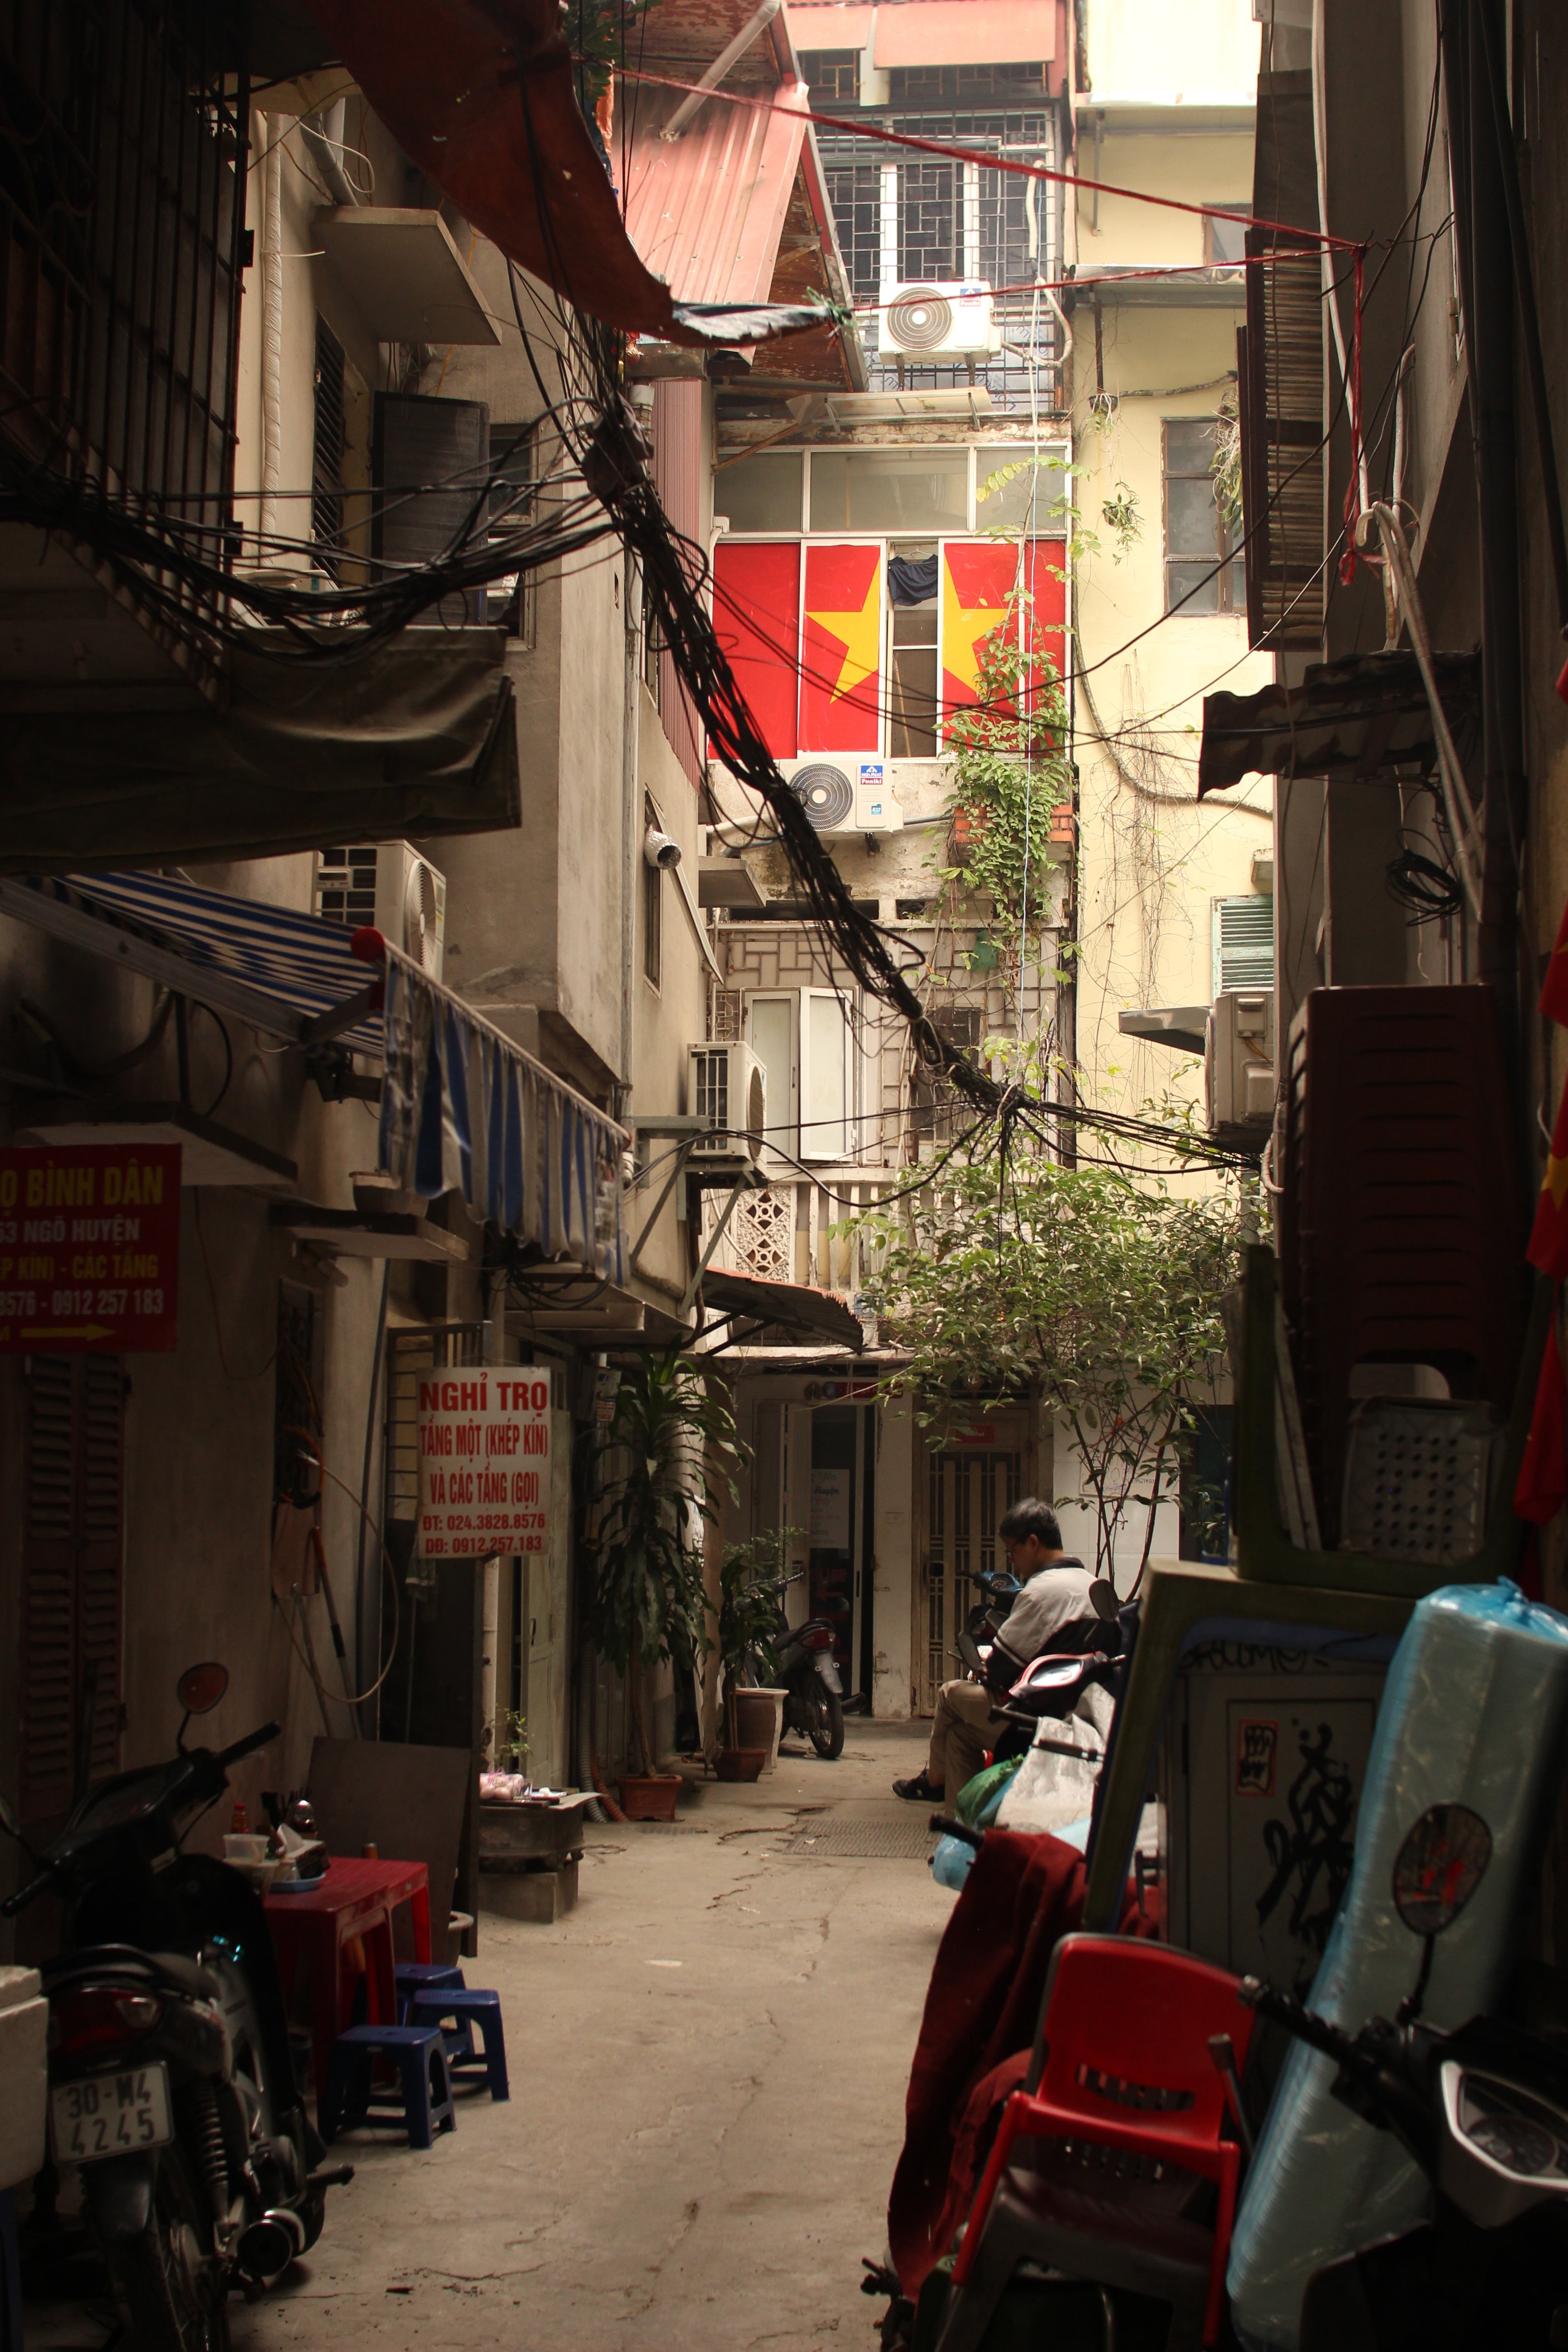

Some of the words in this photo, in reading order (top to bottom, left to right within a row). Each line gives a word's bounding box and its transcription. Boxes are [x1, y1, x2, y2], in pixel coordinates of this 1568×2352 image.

[26, 1160, 95, 1206] BÌNH
[103, 1158, 163, 1205] DÂN
[24, 1215, 66, 1242] NGÕ
[72, 1214, 140, 1246] HUYỆN
[18, 1251, 54, 1282] KÍN)
[72, 1250, 107, 1279] CÁC
[52, 1290, 92, 1315] 0912
[97, 1289, 128, 1314] 257
[134, 1288, 163, 1314] 183
[420, 1372, 487, 1411] NGHỈ
[496, 1382, 548, 1417] TRỌ
[456, 1418, 481, 1463] MỘT
[485, 1417, 520, 1458] (KHÉP
[524, 1417, 548, 1458] KÍN)
[430, 1466, 446, 1504] VÀ
[449, 1465, 473, 1504] CÁC
[511, 1471, 539, 1509] (GỌI)
[423, 1515, 443, 1531] ĐT:
[447, 1513, 545, 1530] 024.3828.8576
[426, 1538, 448, 1554] DĐ:
[452, 1535, 542, 1553] 0912.257.183
[71, 2107, 154, 2155] 4245
